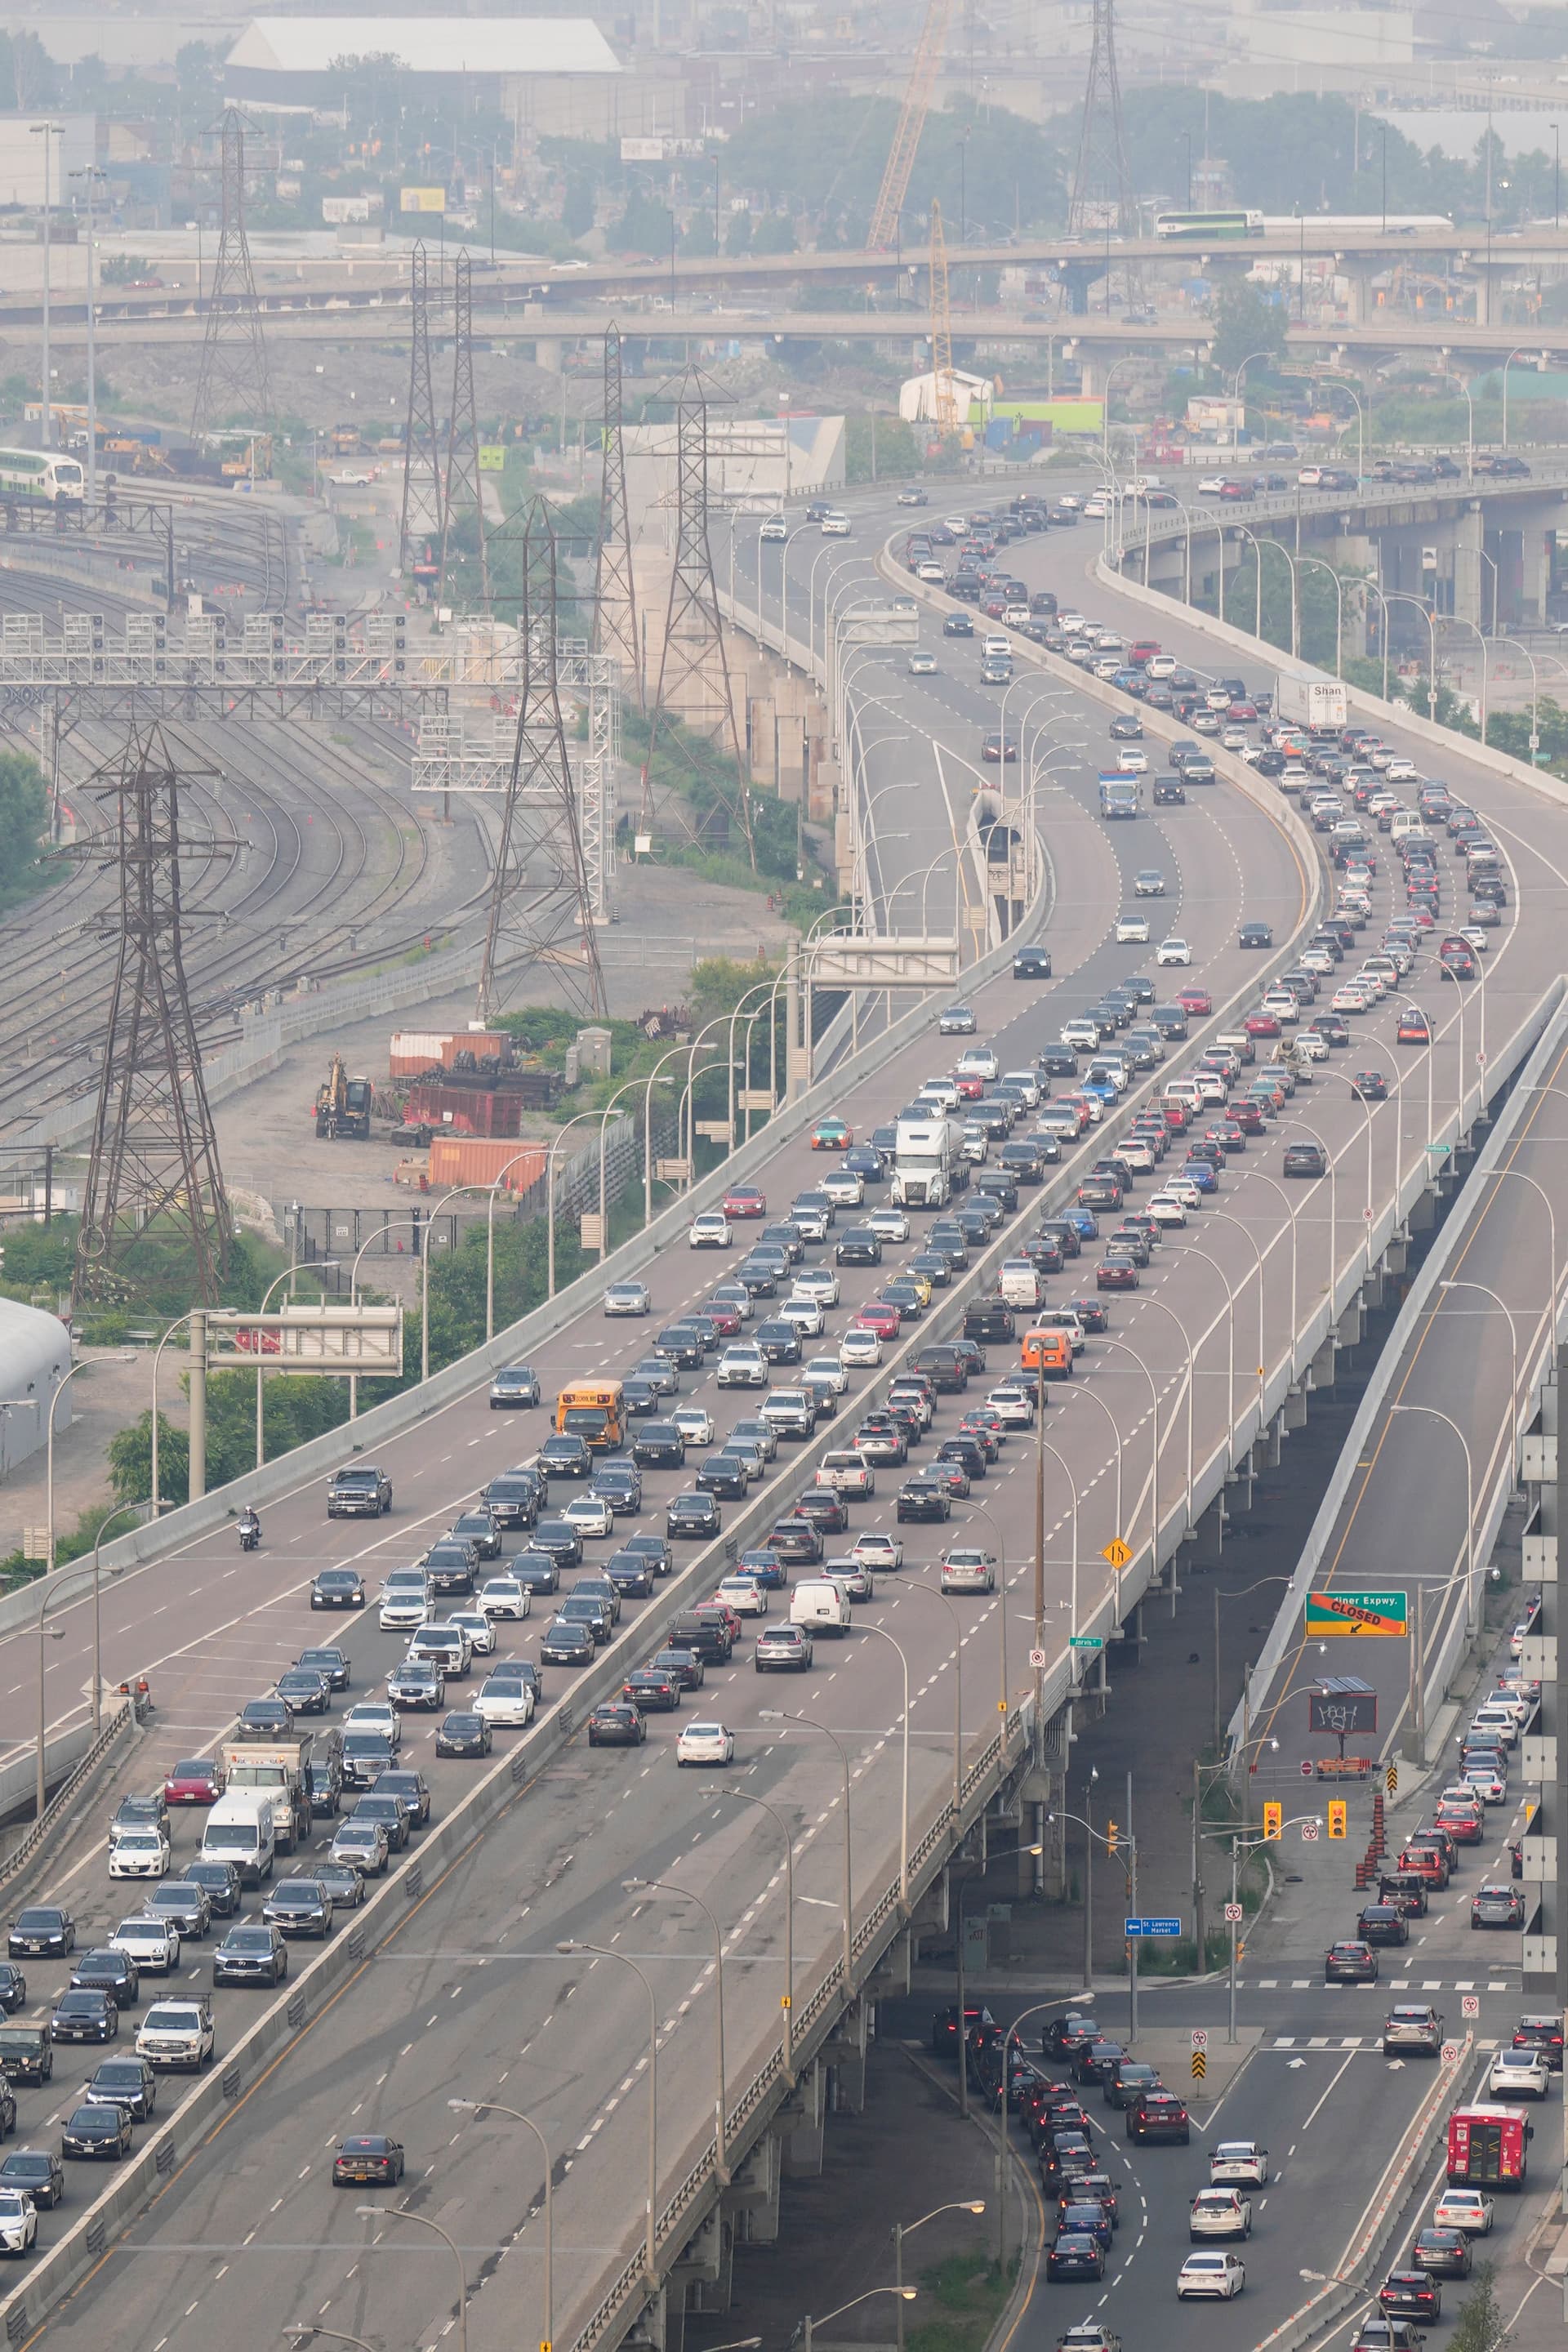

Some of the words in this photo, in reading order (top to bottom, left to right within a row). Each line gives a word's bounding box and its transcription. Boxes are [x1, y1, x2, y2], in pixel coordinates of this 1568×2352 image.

[1314, 686, 1341, 696] Shan
[1334, 1597, 1360, 1605] diner
[1363, 1597, 1398, 1606] Expwy.
[1330, 1601, 1381, 1626] CLOSED
